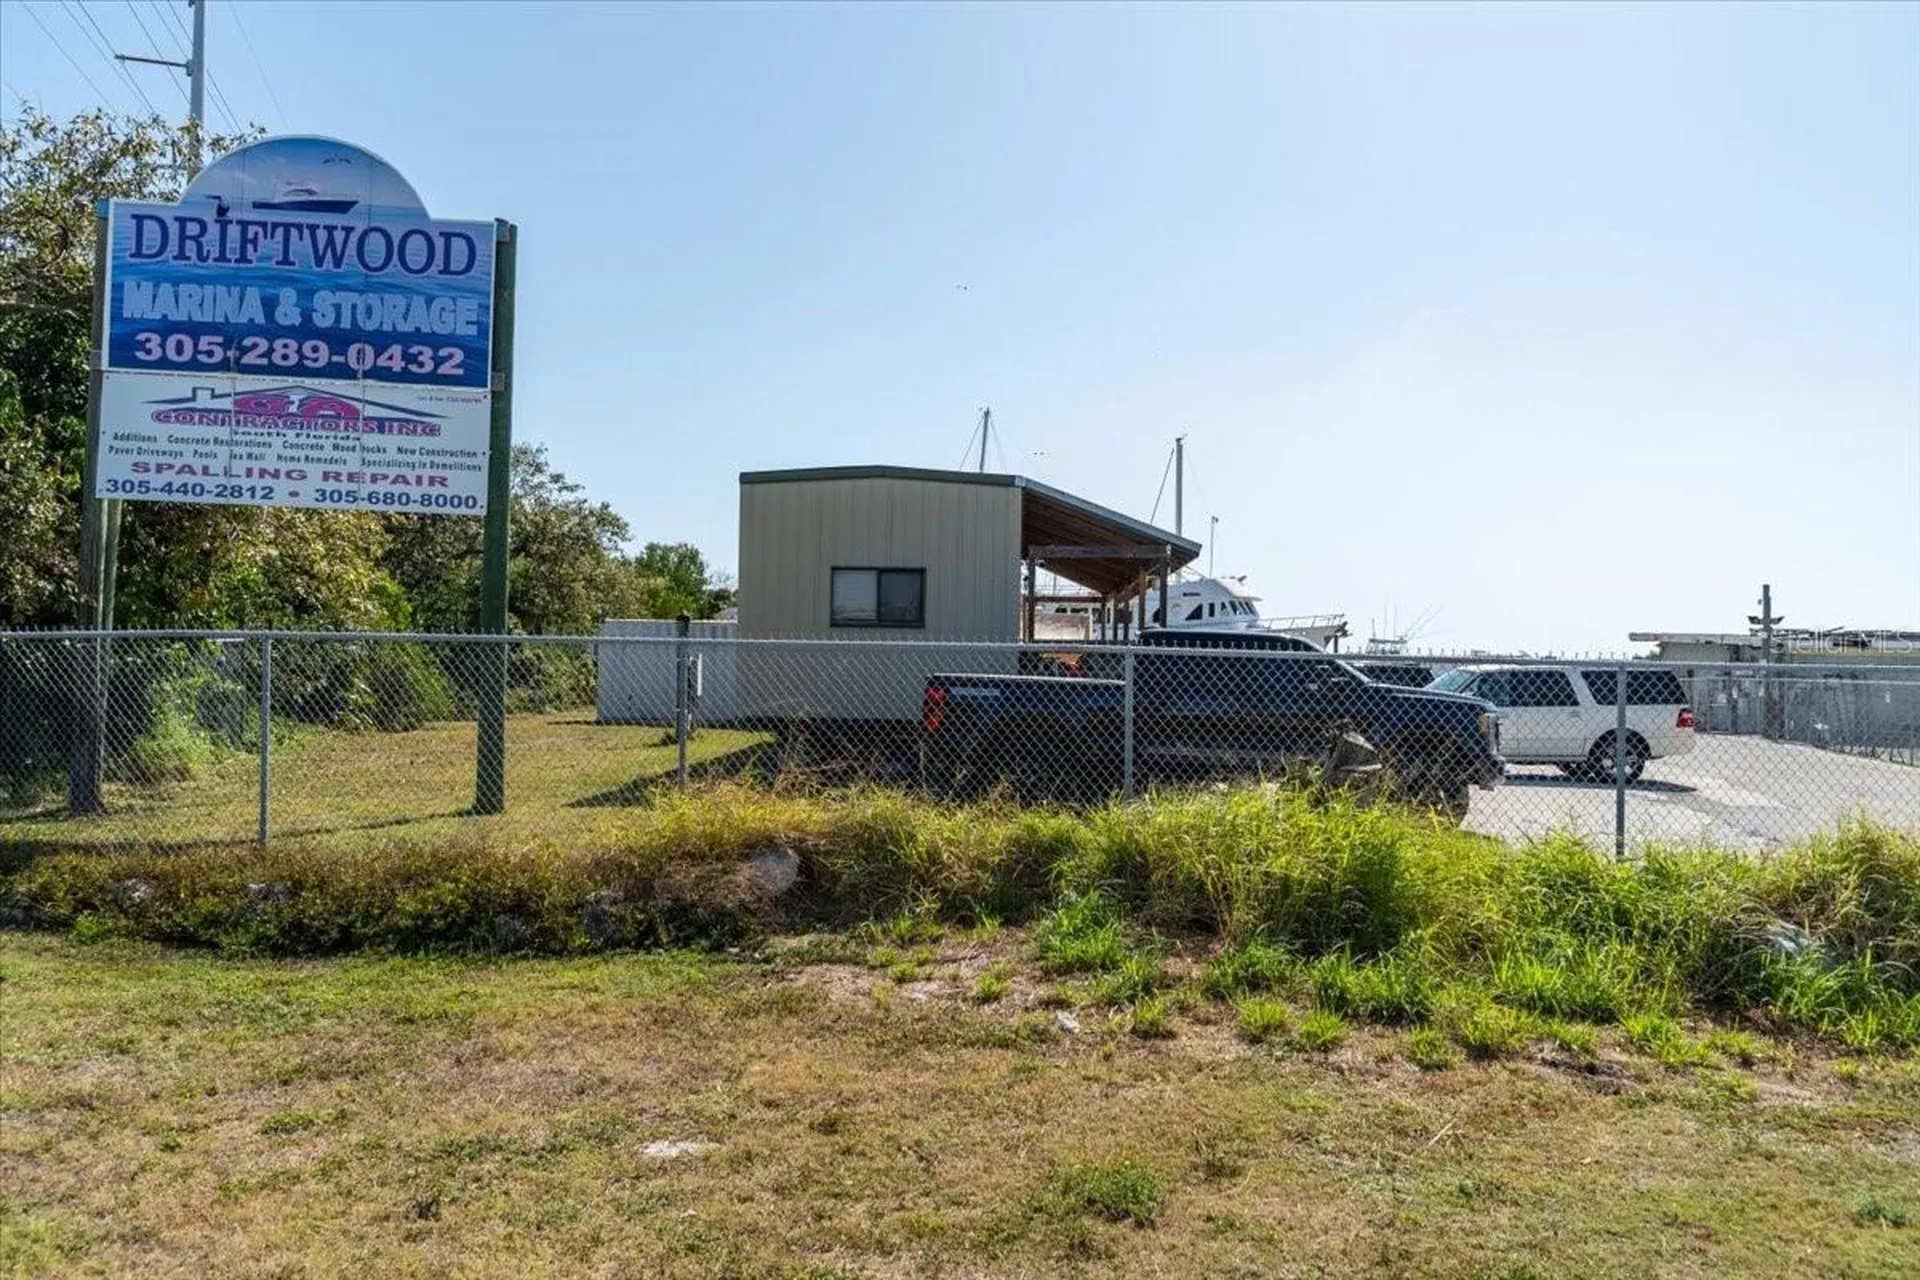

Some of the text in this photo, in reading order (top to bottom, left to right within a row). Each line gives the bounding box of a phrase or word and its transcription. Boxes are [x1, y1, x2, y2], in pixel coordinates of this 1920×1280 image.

[128, 213, 477, 277] DRIFTWOOD
[122, 280, 478, 336] MARINA & STORAGE
[134, 332, 465, 377] 305-289-0432
[151, 409, 442, 437] CONTRACTORS INC
[112, 432, 158, 443] Additions
[167, 434, 210, 446] Concrete
[282, 440, 325, 451] Concrete
[397, 446, 417, 457] New
[418, 447, 478, 459] Construction
[136, 446, 184, 459] Driveways
[130, 461, 449, 488] SPALLING REPAIR
[105, 478, 478, 510] 305-440-2812 305-680-8000
